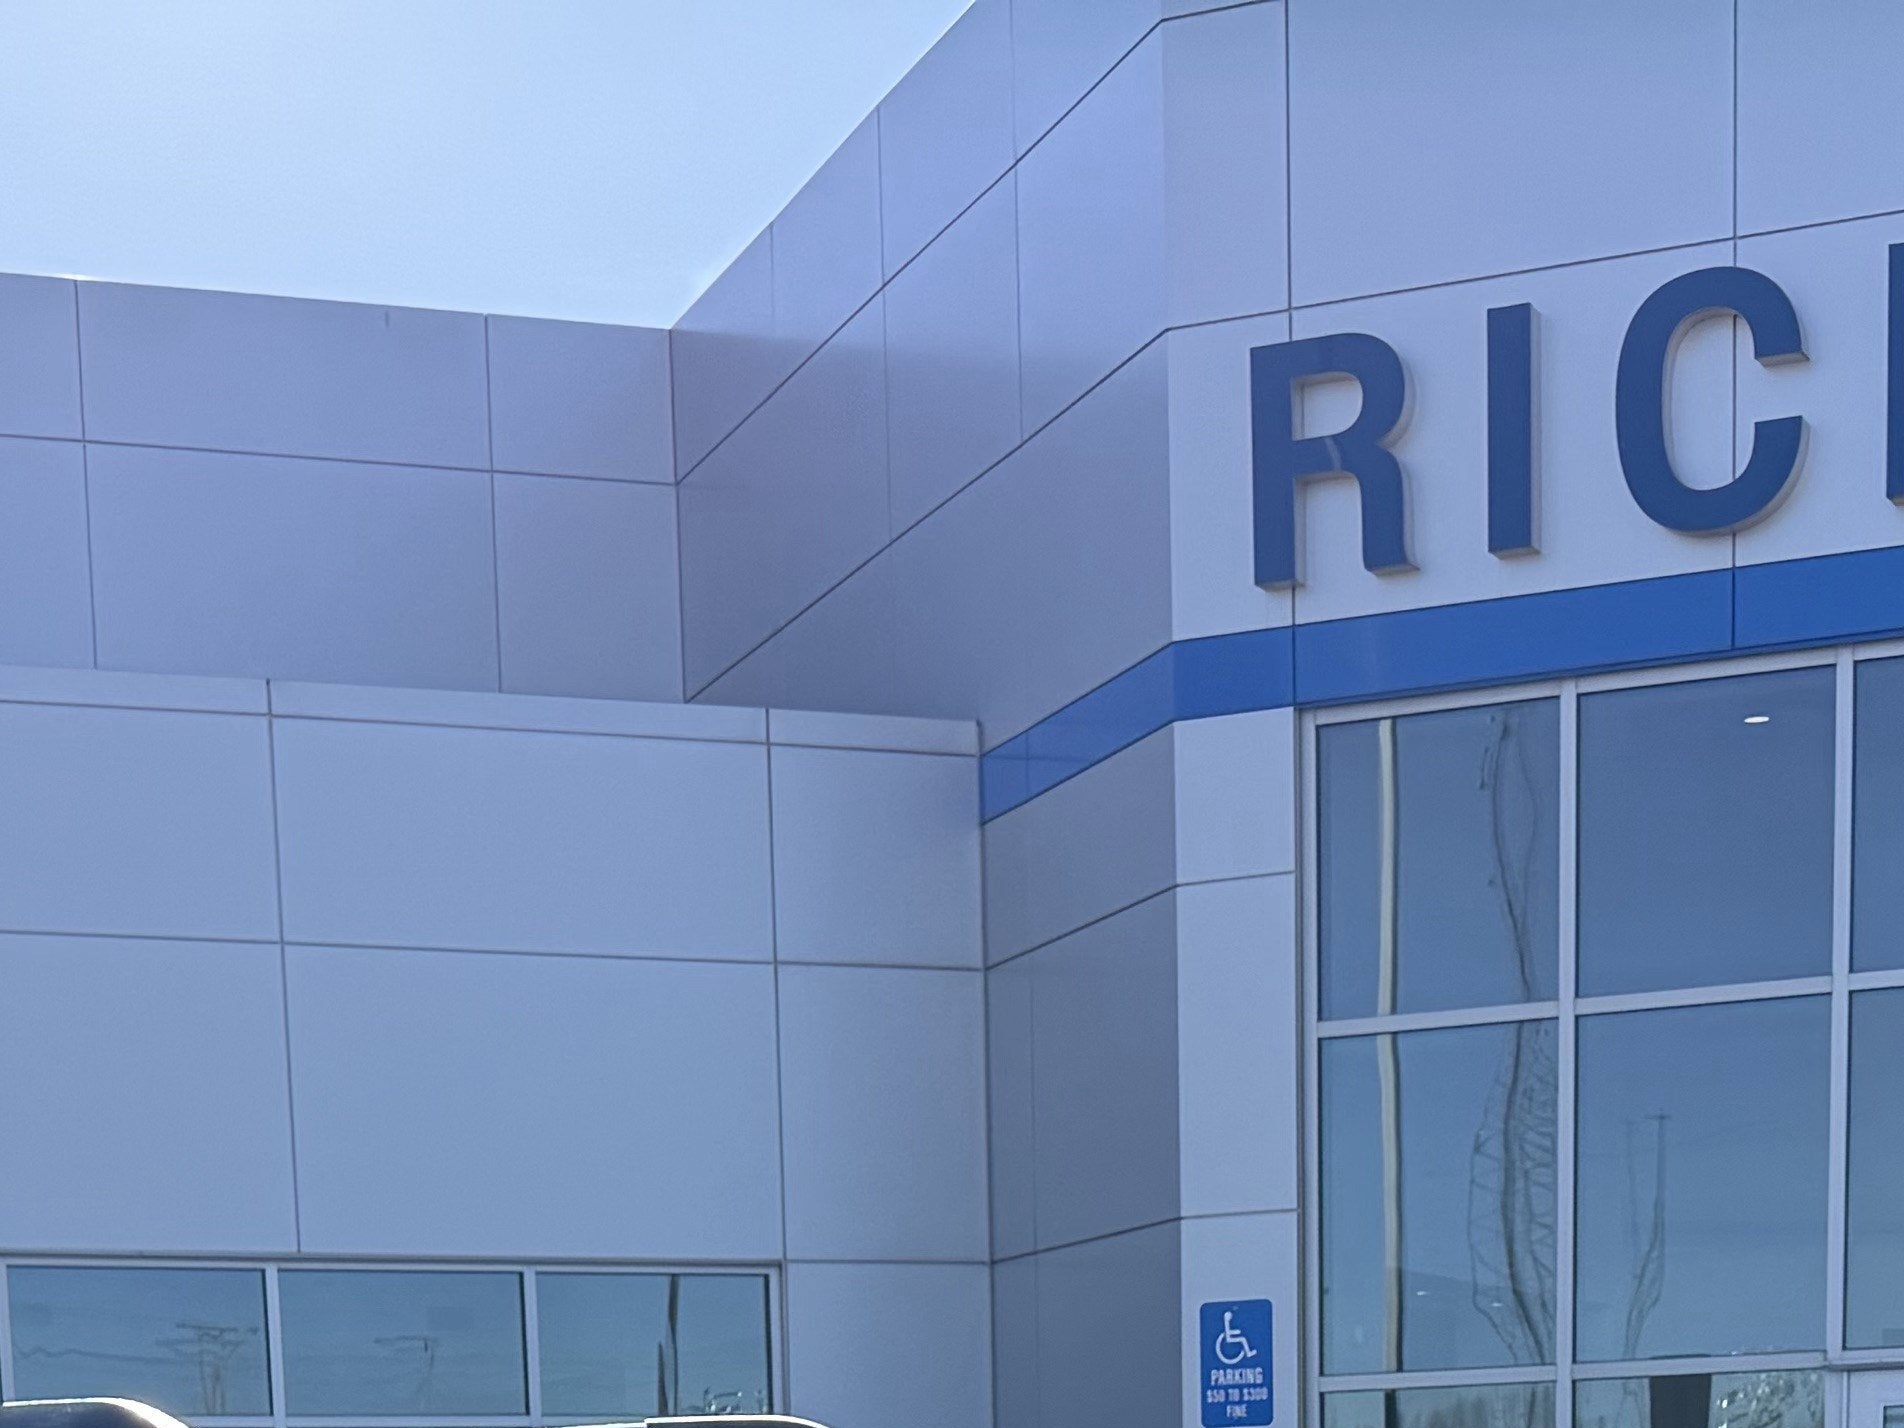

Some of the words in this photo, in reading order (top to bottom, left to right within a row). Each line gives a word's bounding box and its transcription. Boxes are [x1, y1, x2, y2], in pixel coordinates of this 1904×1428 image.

[1210, 1367, 1264, 1386] PARKING
[1228, 1388, 1241, 1402] TO
[1226, 1404, 1247, 1418] FINE
